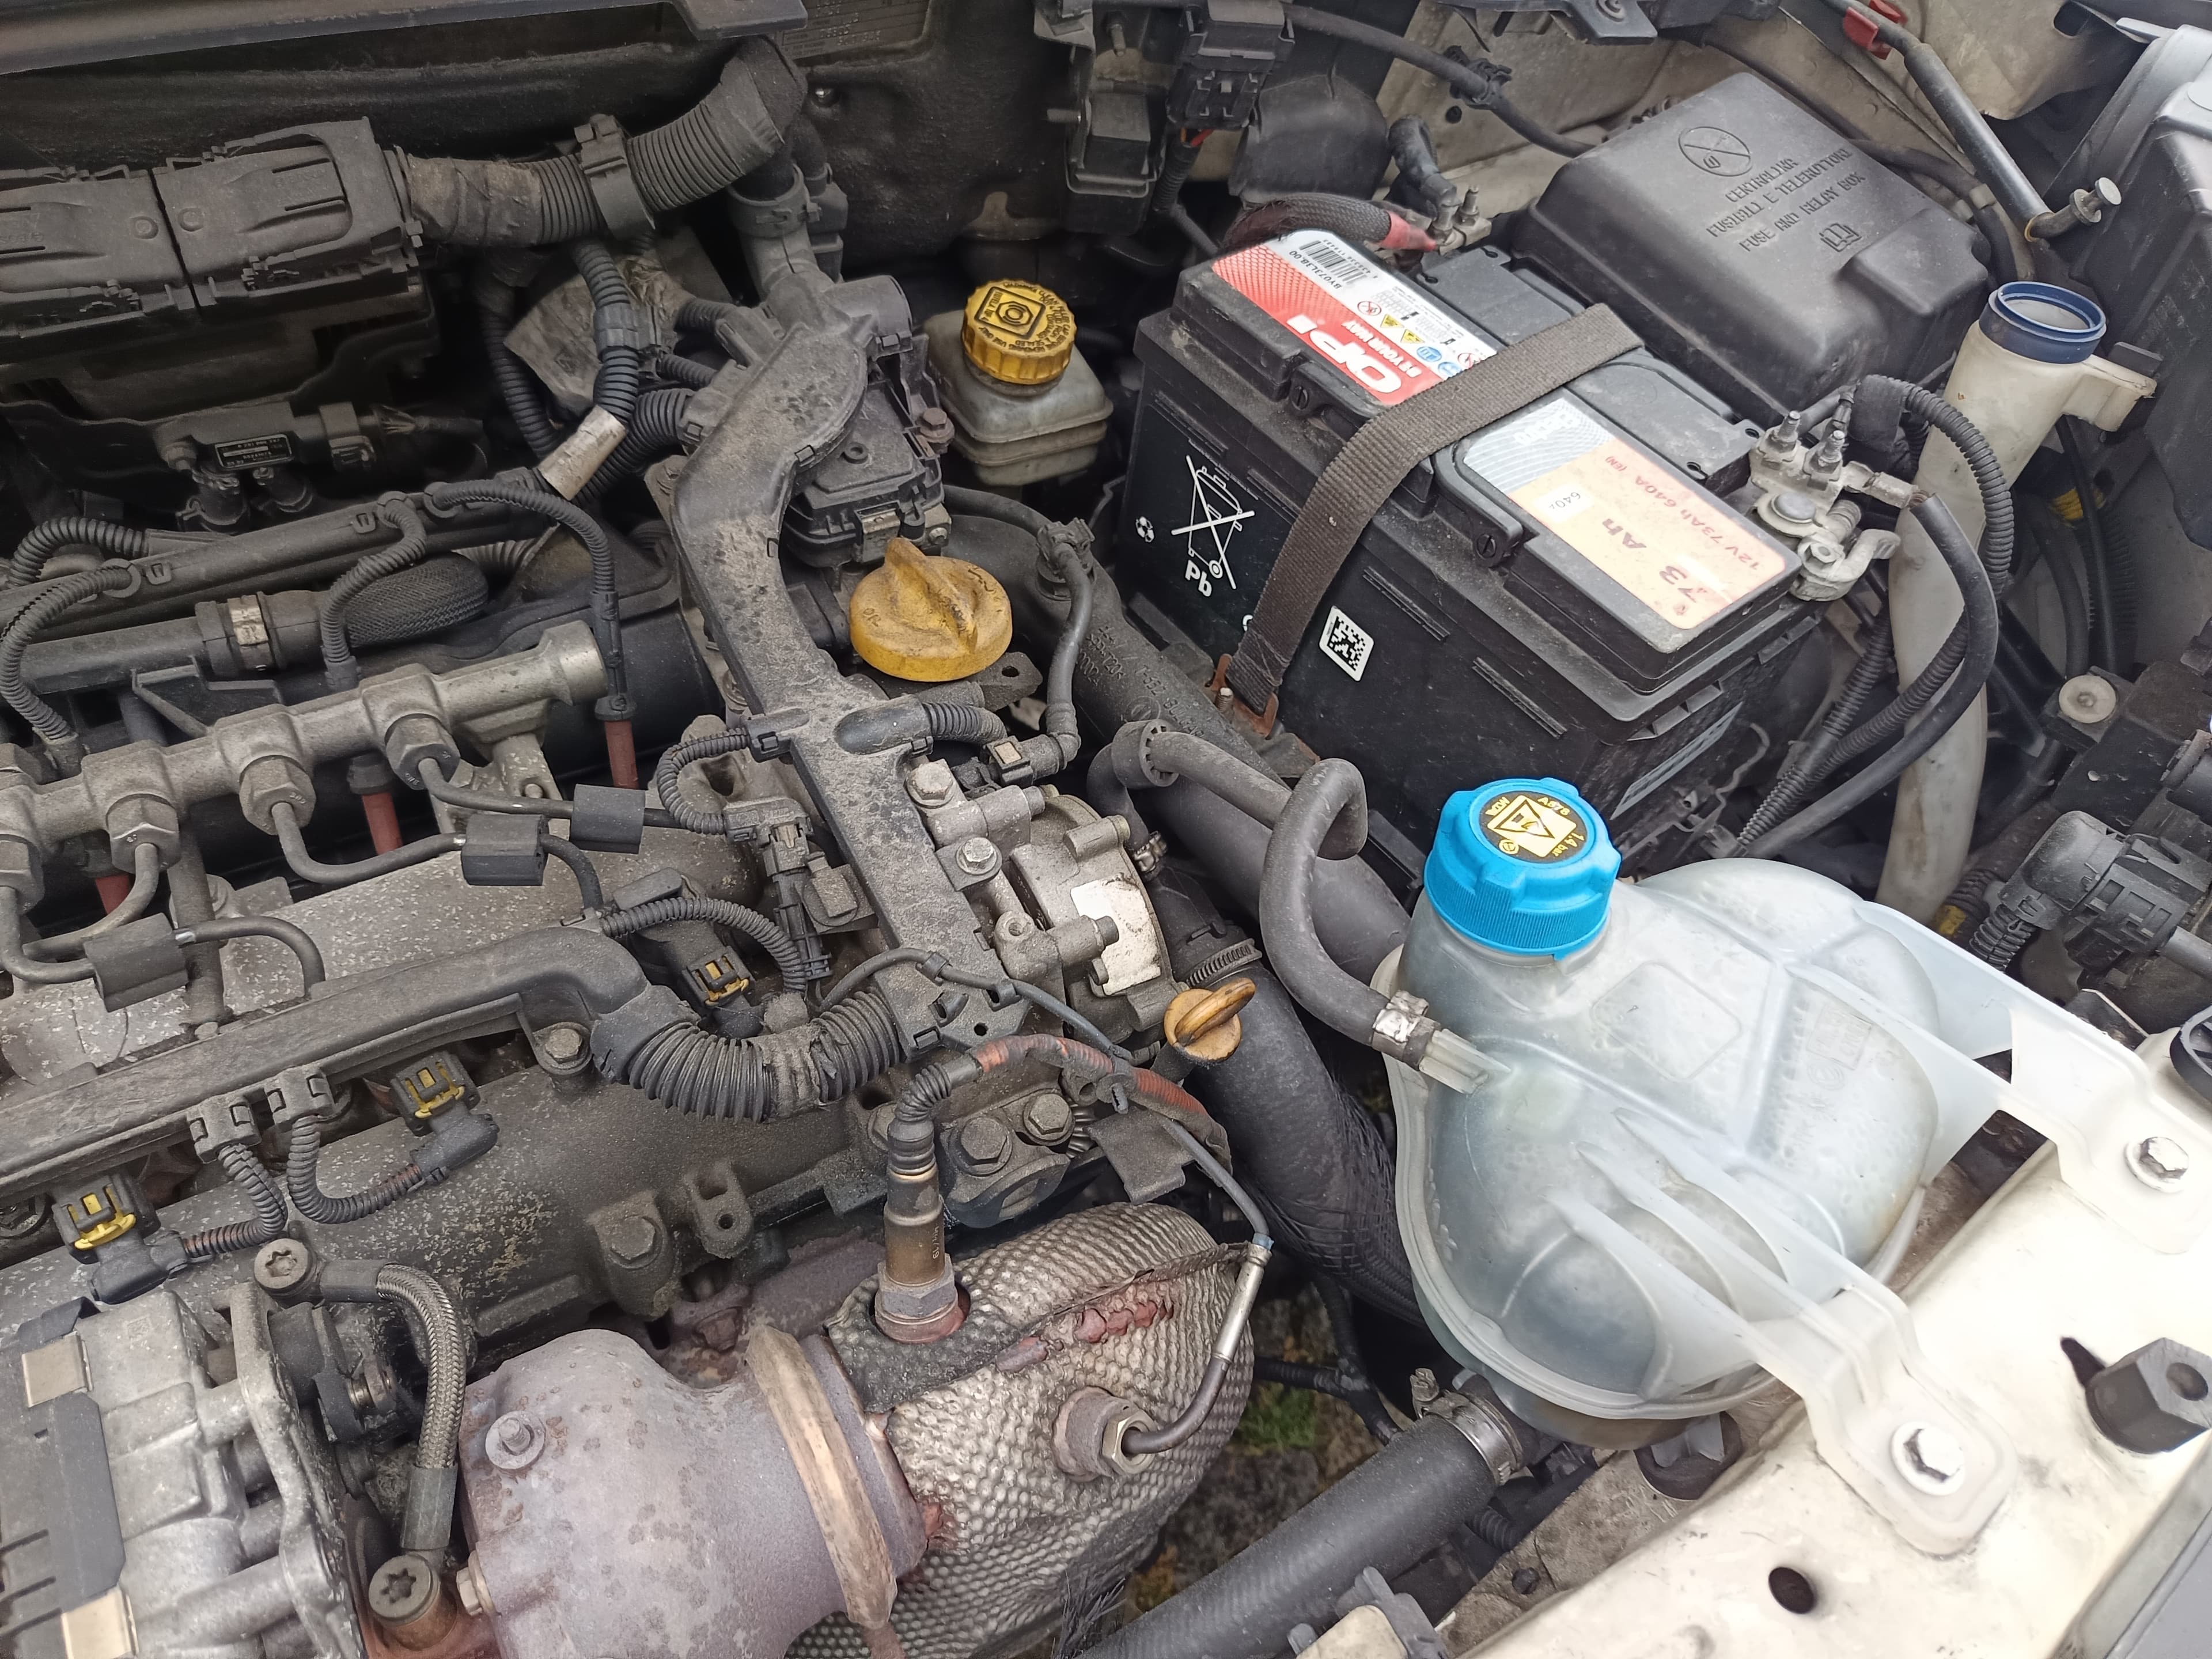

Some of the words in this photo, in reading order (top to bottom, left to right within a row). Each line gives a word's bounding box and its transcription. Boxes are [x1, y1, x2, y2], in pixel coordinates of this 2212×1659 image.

[1706, 202, 1764, 237] FUSIBILI
[1763, 191, 1779, 204] E
[1775, 148, 1853, 195] TELERUTTORI
[1725, 158, 1799, 202] CENTRALINA
[1739, 229, 1776, 252] FUSE
[1774, 212, 1801, 232] AND
[1800, 187, 1840, 215] RELAY
[1837, 172, 1866, 191] BOX
[1341, 320, 1374, 343] WAY
[1368, 337, 1404, 366] YOUR
[1398, 360, 1423, 378] BE
[1605, 456, 1627, 472] (EN)
[1635, 476, 1677, 507] 640A
[1603, 519, 1647, 549] Ah
[1680, 509, 1724, 543] 73Ah
[1725, 546, 1761, 570] 12V
[1185, 559, 1212, 597] Pb
[1537, 797, 1570, 816] A878
[1552, 844, 1569, 857] bar
[1564, 832, 1585, 847] 1.4
